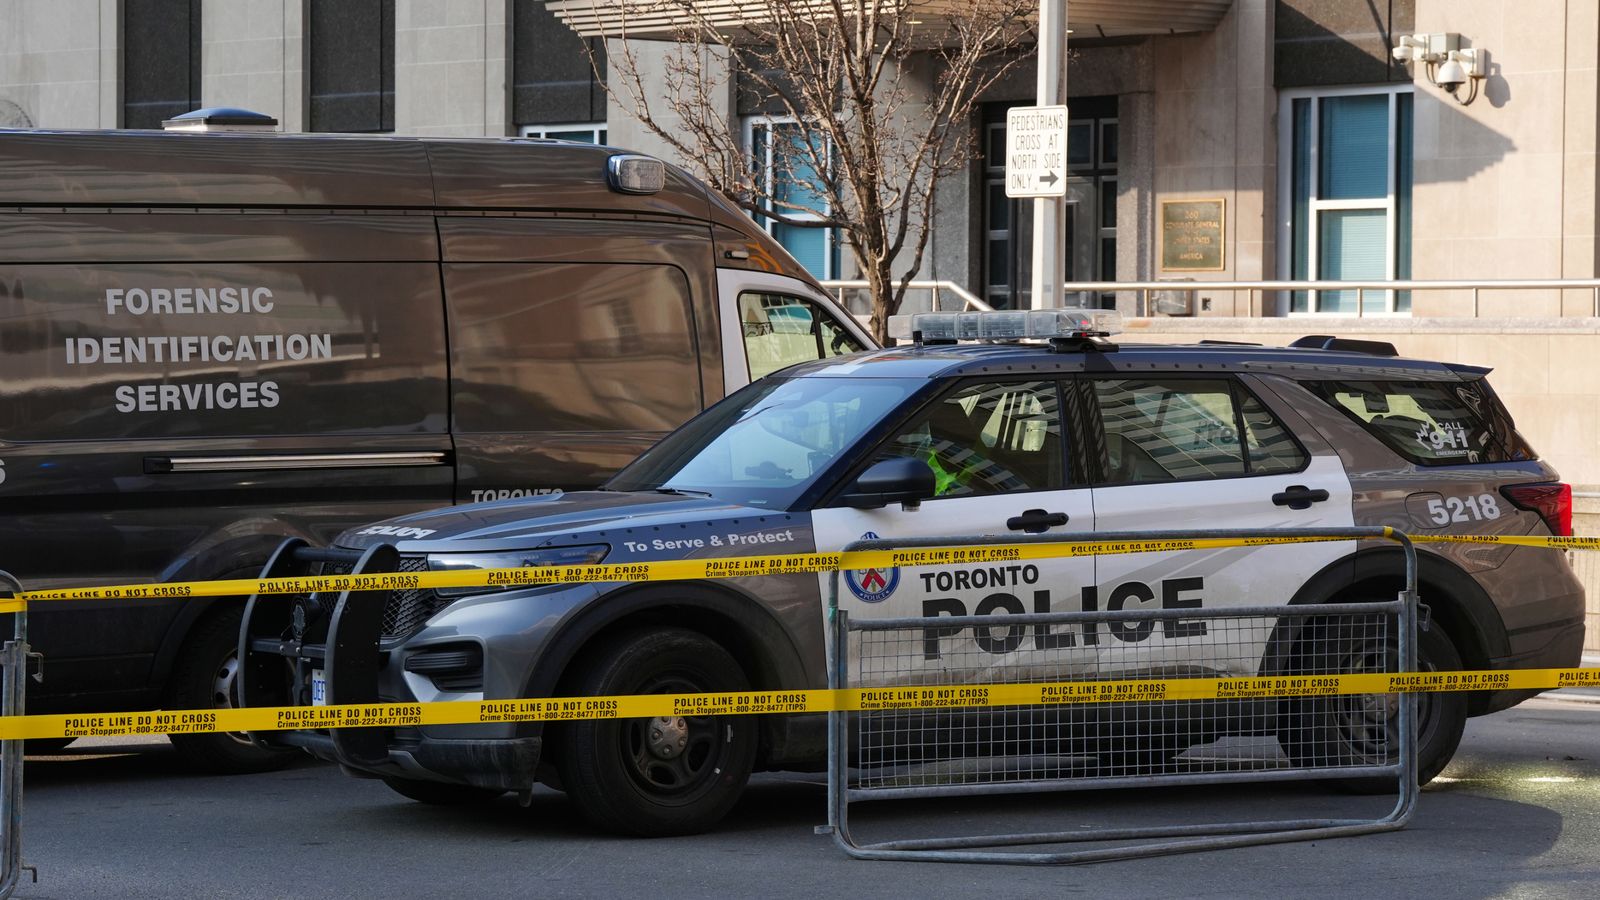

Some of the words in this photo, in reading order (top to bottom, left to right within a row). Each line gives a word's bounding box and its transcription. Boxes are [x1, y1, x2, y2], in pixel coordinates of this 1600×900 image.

[1011, 114, 1063, 131] PEDESTRIANS
[1016, 134, 1040, 150] CROSS
[1049, 133, 1058, 149] AT
[1012, 154, 1036, 170] NORTH
[1044, 153, 1060, 168] SIDE
[1012, 174, 1031, 189] ONLY
[106, 287, 274, 315] FORENSIC
[66, 334, 331, 364] IDENTIFICATION
[115, 381, 279, 413] SERVICES
[1437, 422, 1464, 430] CALL
[471, 488, 563, 503] TORO
[1427, 493, 1501, 525] 5218
[624, 541, 647, 553] To
[655, 537, 704, 551] Serve
[710, 535, 723, 547] &
[729, 529, 794, 546] Protect
[893, 553, 925, 561] POLICE
[706, 562, 740, 570] POLICE
[489, 571, 528, 580] POLICE
[556, 574, 622, 582] 1-800-222-8477
[920, 564, 1039, 592] TORONTO
[259, 582, 300, 590] POLICE
[306, 580, 329, 588] LINE
[382, 575, 419, 584] CROSS
[154, 586, 191, 595] CROSS
[922, 576, 1208, 660] POLICE
[1390, 676, 1421, 685] POLICE
[1425, 676, 1443, 684] LINE
[1461, 675, 1478, 683] NOT
[1482, 674, 1509, 682] CROSS
[1559, 672, 1590, 680] POLICE
[1042, 686, 1073, 695] POLICE
[1078, 686, 1096, 694] LINE
[1101, 685, 1112, 693] DO
[1117, 685, 1133, 693] NOT
[1137, 684, 1166, 692] CROSS
[1218, 682, 1248, 690] POLICE
[1253, 681, 1272, 689] LINE
[1276, 680, 1287, 688] DO
[1291, 680, 1307, 688] NOT
[674, 697, 708, 707] POLICE
[713, 697, 733, 705] LINE
[738, 696, 749, 704] DO
[754, 696, 771, 704] NOT
[776, 694, 806, 703] CROSS
[861, 691, 893, 700] POLICE
[898, 691, 918, 699] LINE
[922, 690, 934, 698] DO
[938, 690, 955, 698] NOT
[960, 688, 988, 697] CROSS
[481, 704, 515, 713] POLICE
[520, 703, 541, 712] LINE
[547, 702, 558, 711] DO
[564, 702, 581, 710] NOT
[586, 700, 618, 709] CROSS
[278, 711, 314, 720] POLICE
[320, 710, 341, 718] LINE
[347, 709, 359, 718] DO
[365, 708, 384, 716] NOT
[389, 707, 421, 716] CROSS
[538, 711, 593, 719] 1-800-222-8477
[66, 718, 103, 728] POLICE
[110, 717, 132, 726] LINE
[138, 716, 151, 725] DO
[157, 715, 176, 724] NOT
[182, 714, 216, 723] CROSS
[302, 720, 335, 728] Stoppers
[338, 717, 396, 725] 1-800-222-8477
[128, 724, 189, 733] 1-800-222-8477
